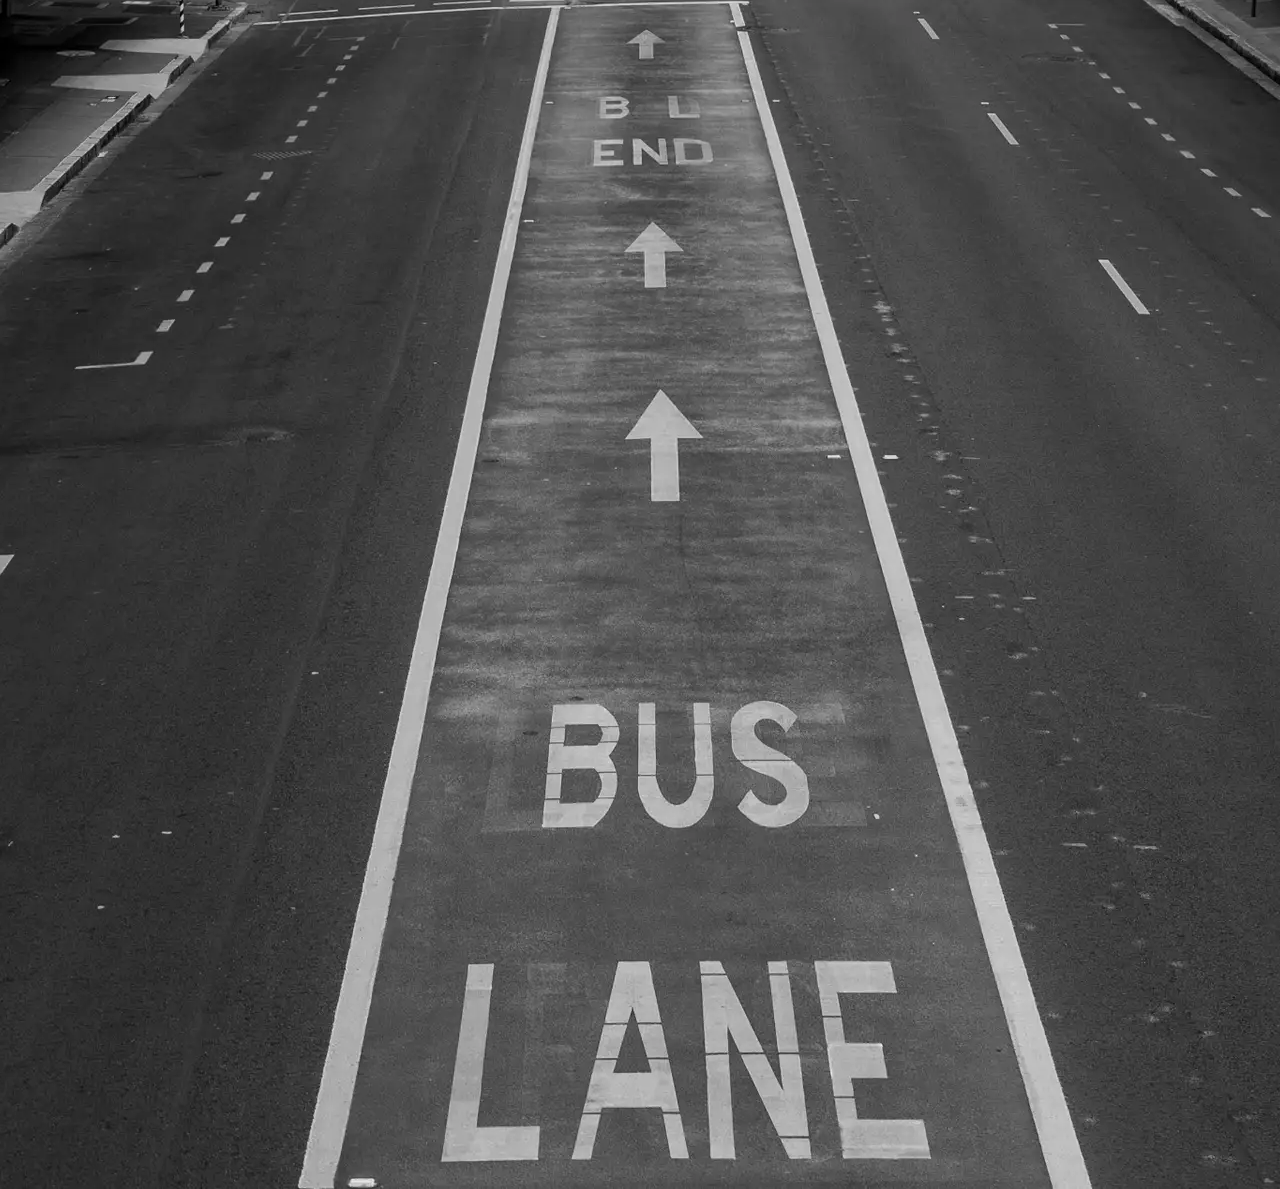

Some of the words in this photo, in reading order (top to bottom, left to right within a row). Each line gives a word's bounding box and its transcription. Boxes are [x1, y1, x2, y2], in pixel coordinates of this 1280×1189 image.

[593, 137, 714, 167] END
[542, 700, 810, 830] BUS
[441, 959, 932, 1164] LANE
